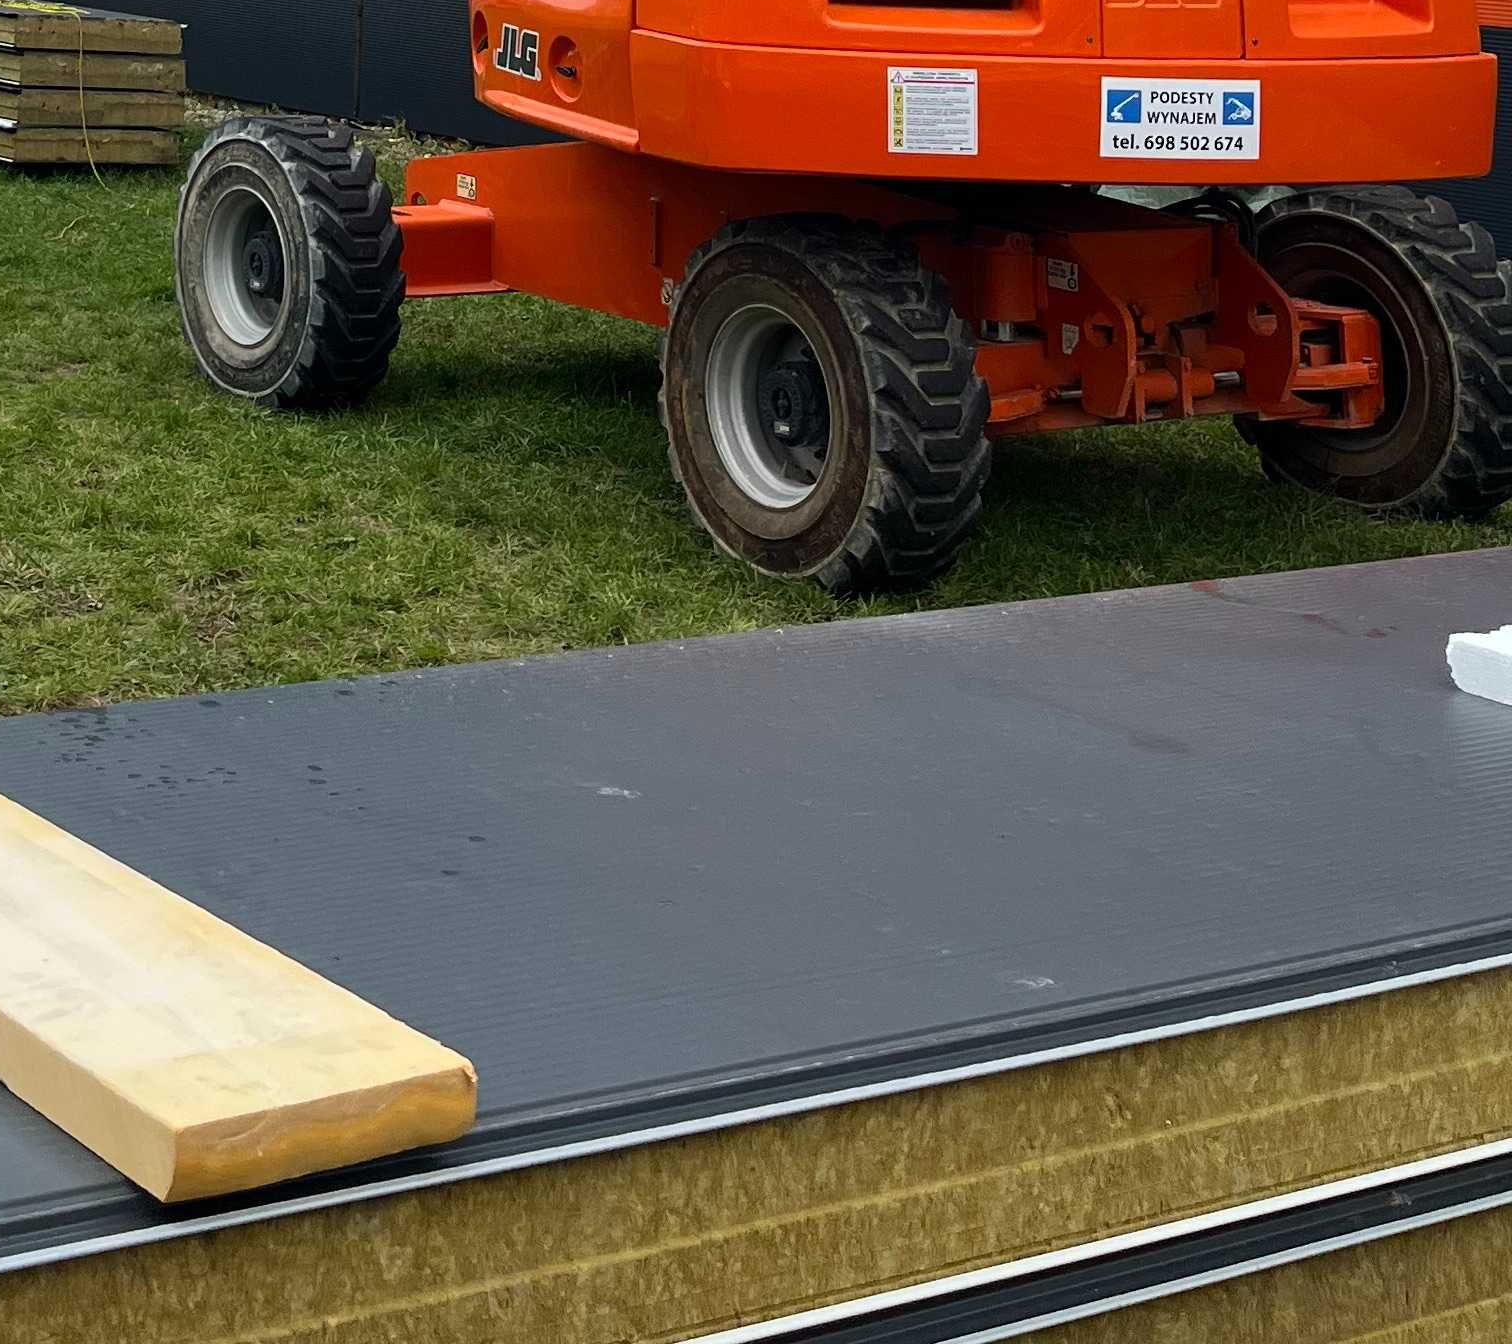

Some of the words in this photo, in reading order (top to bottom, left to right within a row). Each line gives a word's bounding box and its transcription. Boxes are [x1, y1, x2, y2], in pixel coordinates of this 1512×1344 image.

[495, 23, 540, 80] JLG
[1150, 91, 1214, 105] PODESTY
[1147, 112, 1216, 125] WYNAJEM
[1113, 134, 1139, 150] tel.
[1144, 135, 1175, 150] 698
[1180, 136, 1209, 151] 502
[1214, 137, 1243, 151] 674
